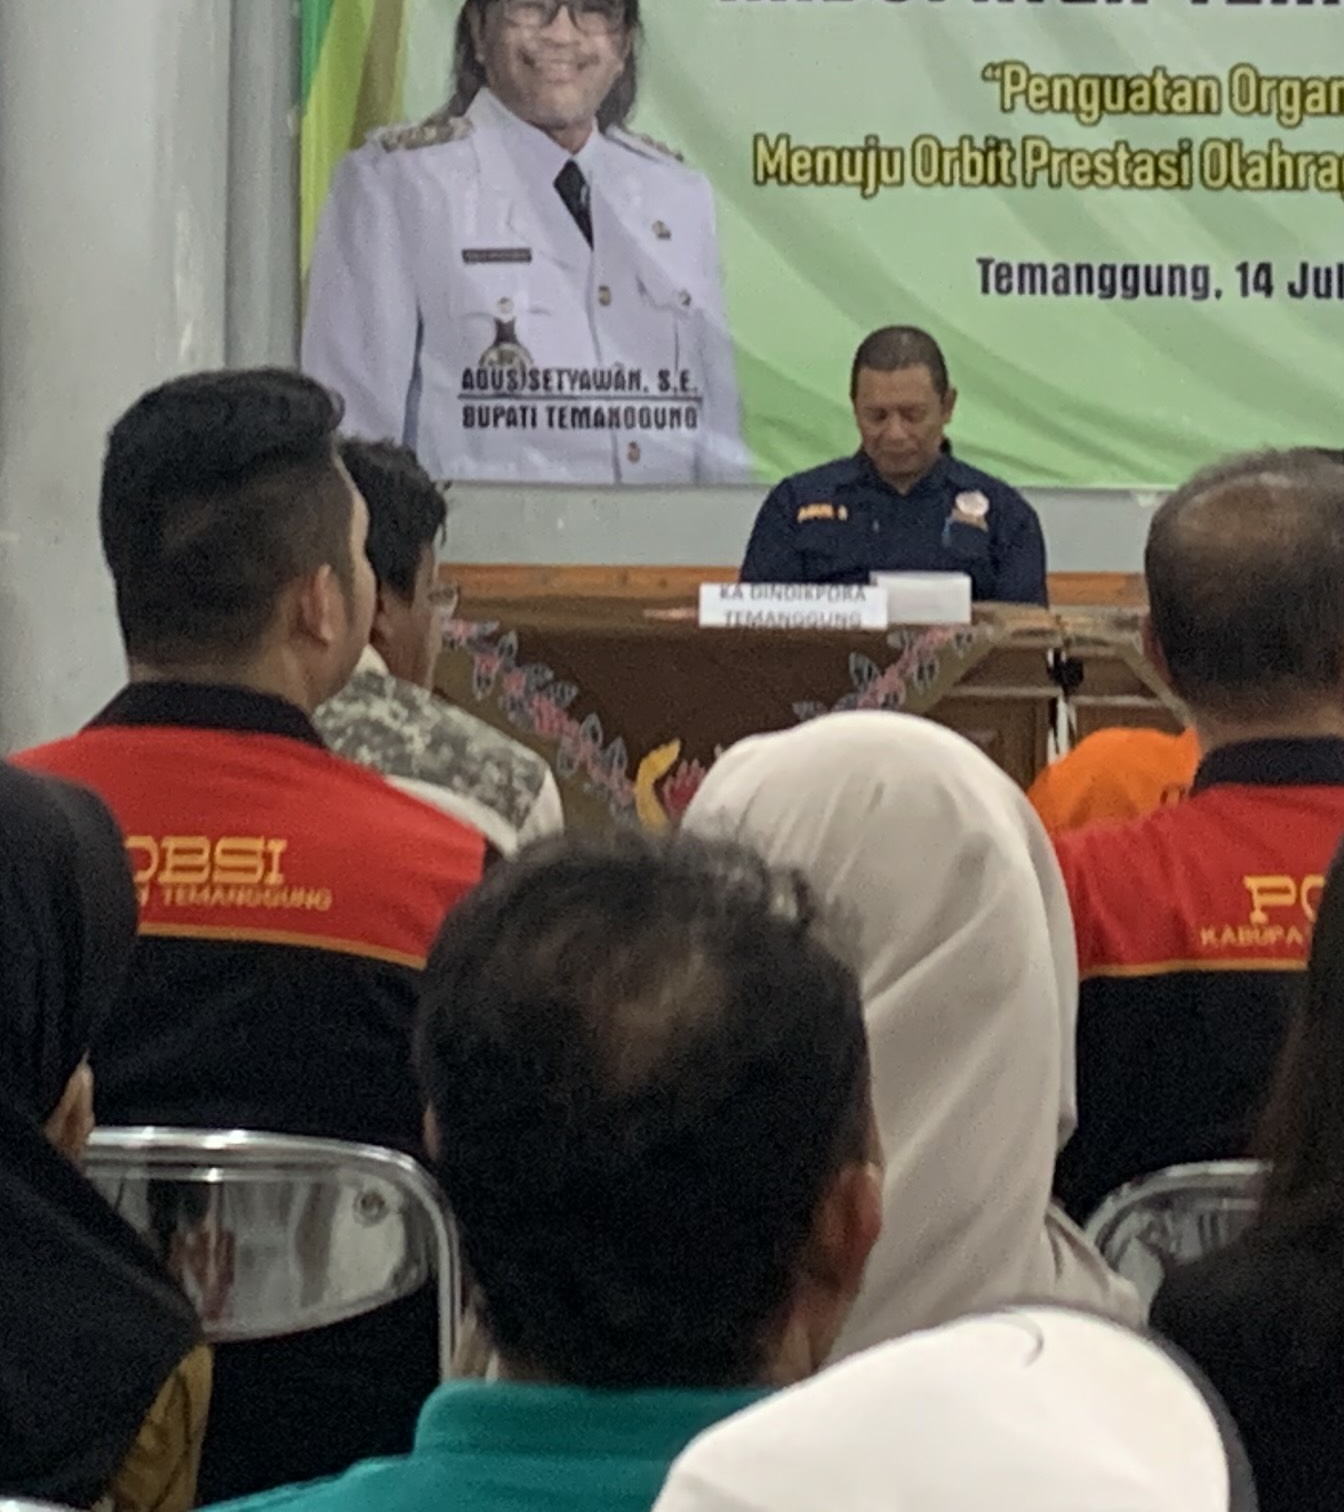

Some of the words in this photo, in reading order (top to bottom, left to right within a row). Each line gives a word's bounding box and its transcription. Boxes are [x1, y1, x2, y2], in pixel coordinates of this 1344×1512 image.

[982, 60, 1223, 126] “Penguatan
[754, 133, 904, 199] Menuju
[911, 135, 1017, 188] Orbit
[1022, 135, 1193, 189] Prestasi
[976, 257, 1223, 301] Temanggung,
[1235, 262, 1273, 300] 14
[461, 368, 520, 391] AGUS
[462, 405, 538, 429] BUPATI
[546, 405, 699, 430] TEMANGGUNG
[724, 610, 862, 628] TEMANGGUNG
[1199, 924, 1305, 947] KABUPA
